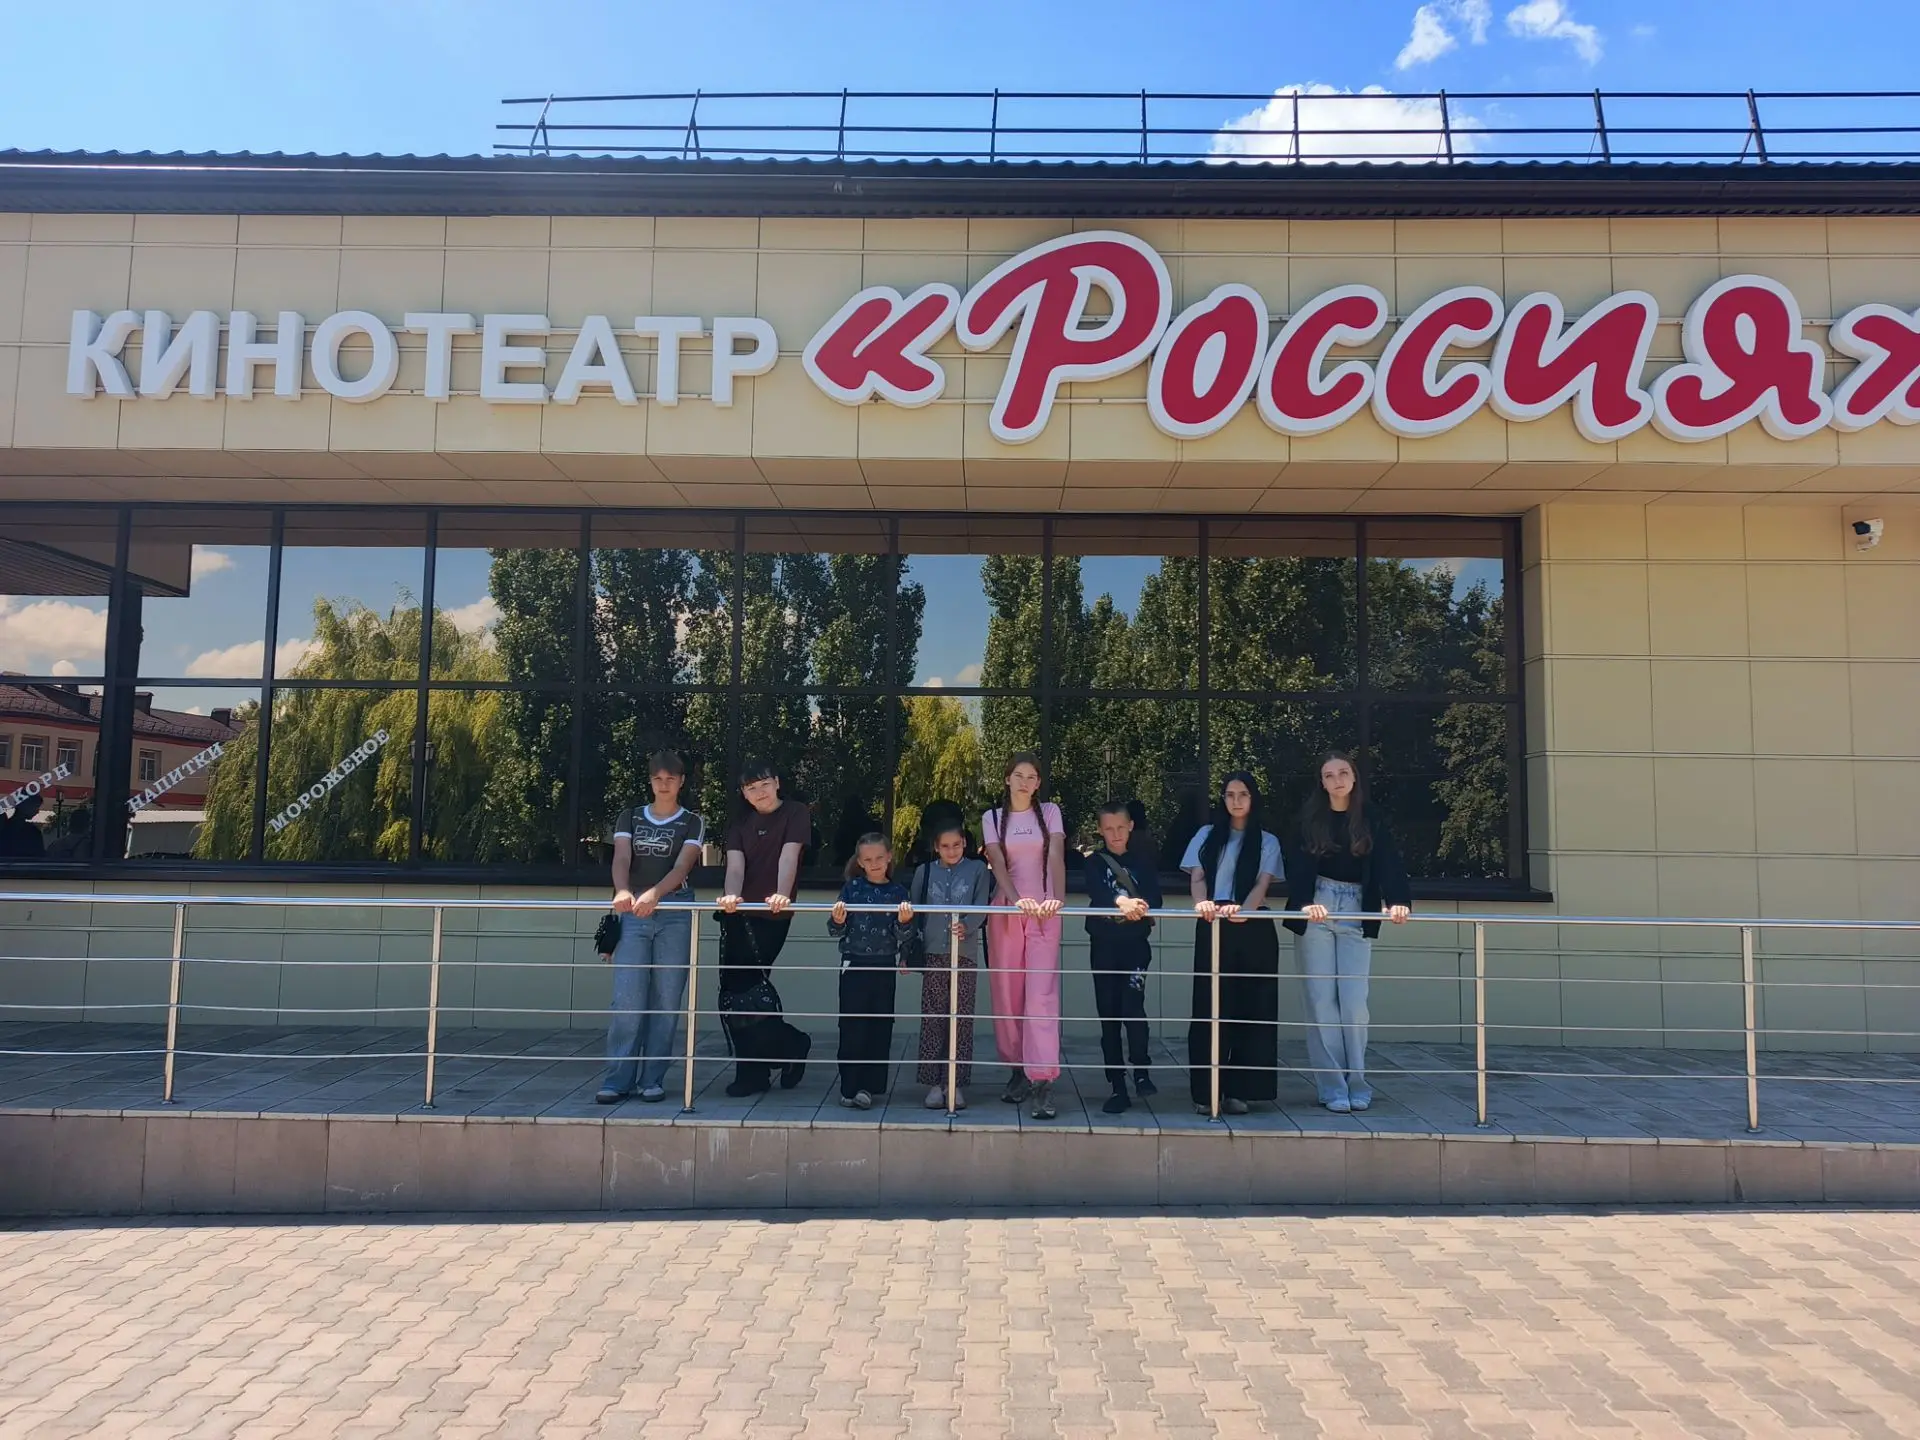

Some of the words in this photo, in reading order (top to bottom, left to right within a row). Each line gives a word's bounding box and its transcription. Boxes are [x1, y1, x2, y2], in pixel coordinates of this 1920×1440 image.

[66, 310, 779, 407] КИНОТЕАТР
[126, 741, 225, 812] НАПИТКИ
[267, 728, 391, 834] МОРОЖЕНОЕ
